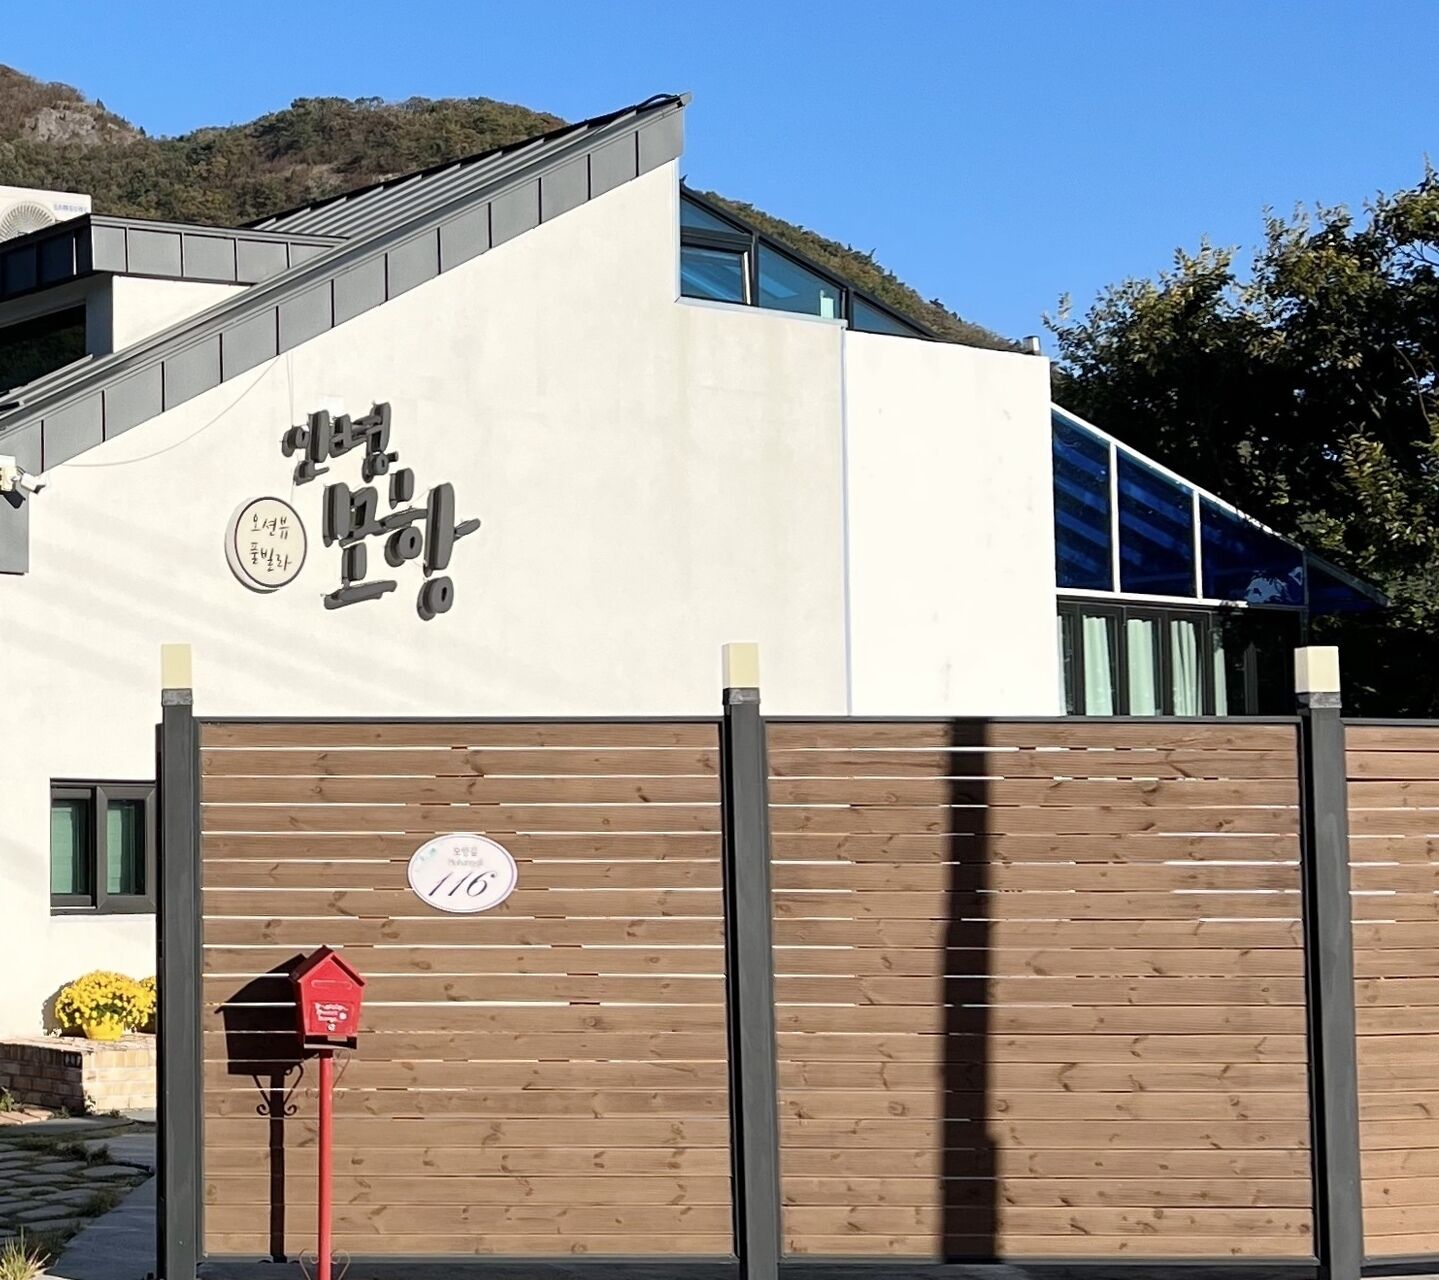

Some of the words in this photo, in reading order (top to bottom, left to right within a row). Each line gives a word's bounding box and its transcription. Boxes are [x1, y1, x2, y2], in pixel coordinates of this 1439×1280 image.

[250, 513, 290, 540] 오션뷰
[250, 541, 292, 572] 풀빌라
[322, 467, 481, 621] 모항
[428, 870, 497, 897] 116
